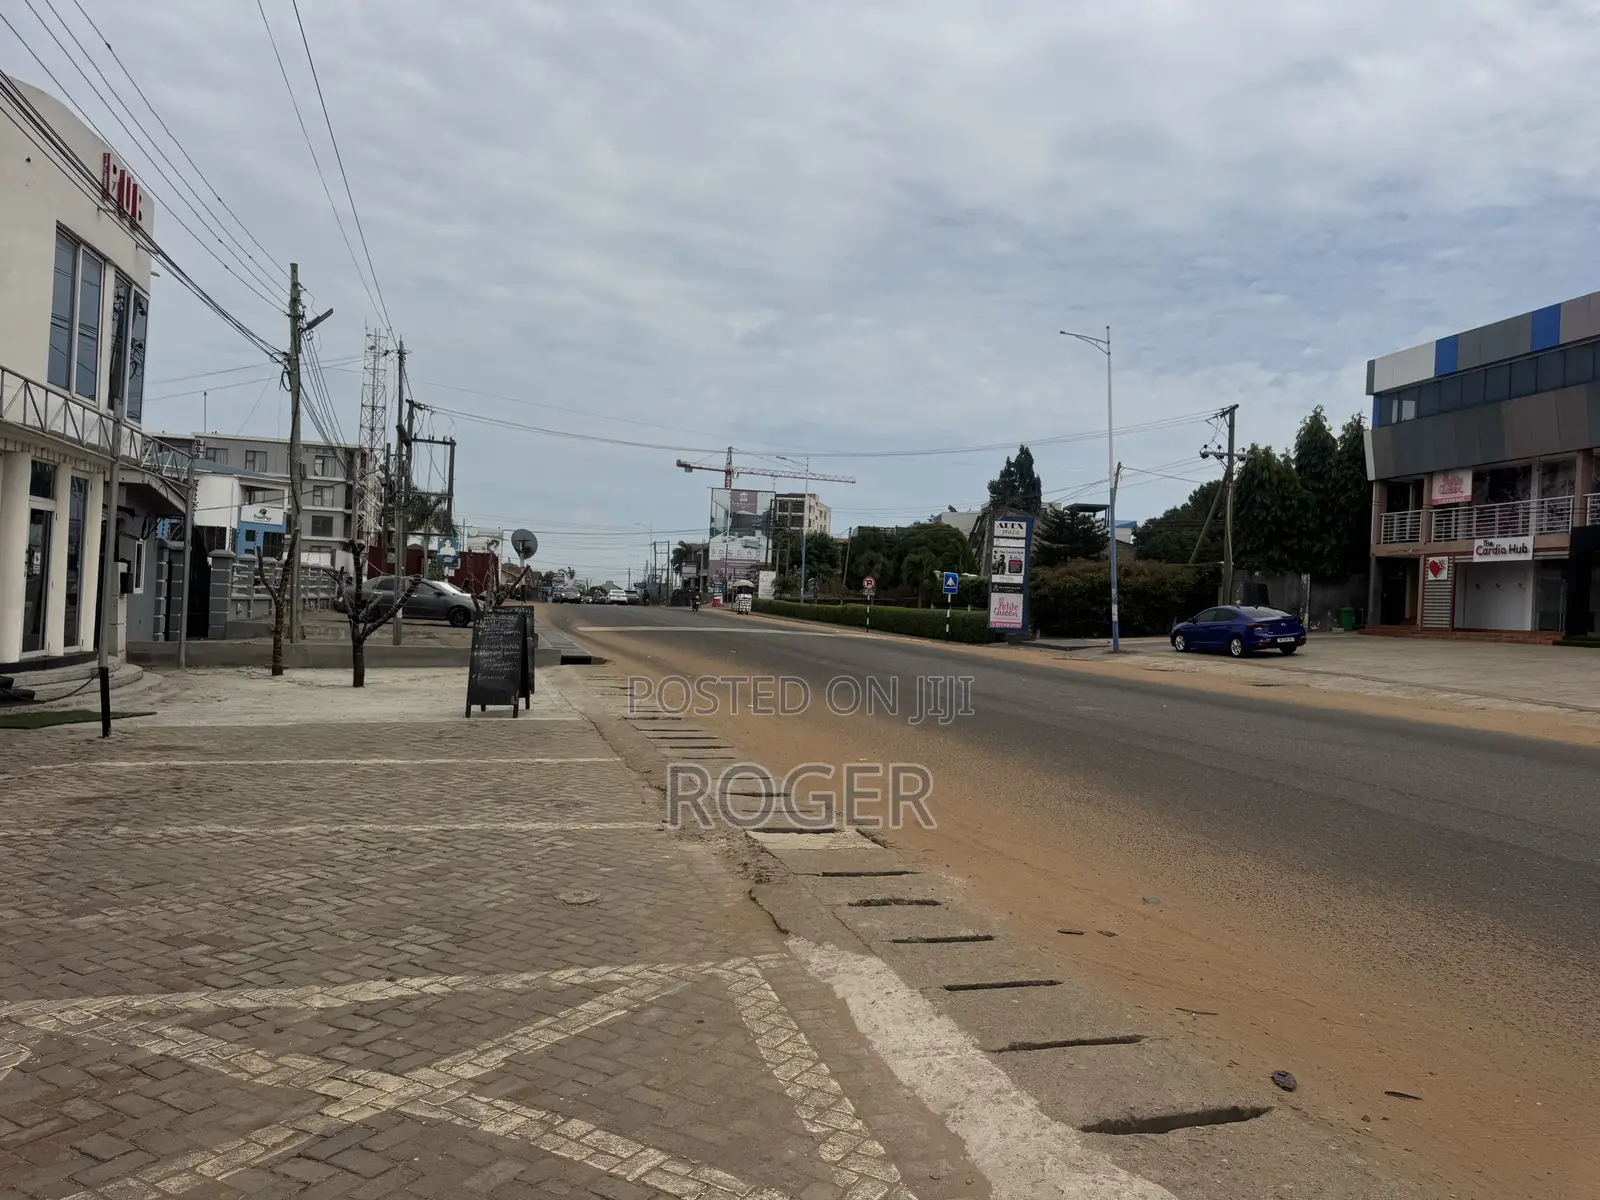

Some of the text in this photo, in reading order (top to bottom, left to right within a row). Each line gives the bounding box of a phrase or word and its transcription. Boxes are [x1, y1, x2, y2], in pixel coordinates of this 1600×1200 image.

[1476, 543, 1528, 556] Cardio Hub
[998, 601, 1019, 611] Petite
[994, 607, 1019, 617] Queen
